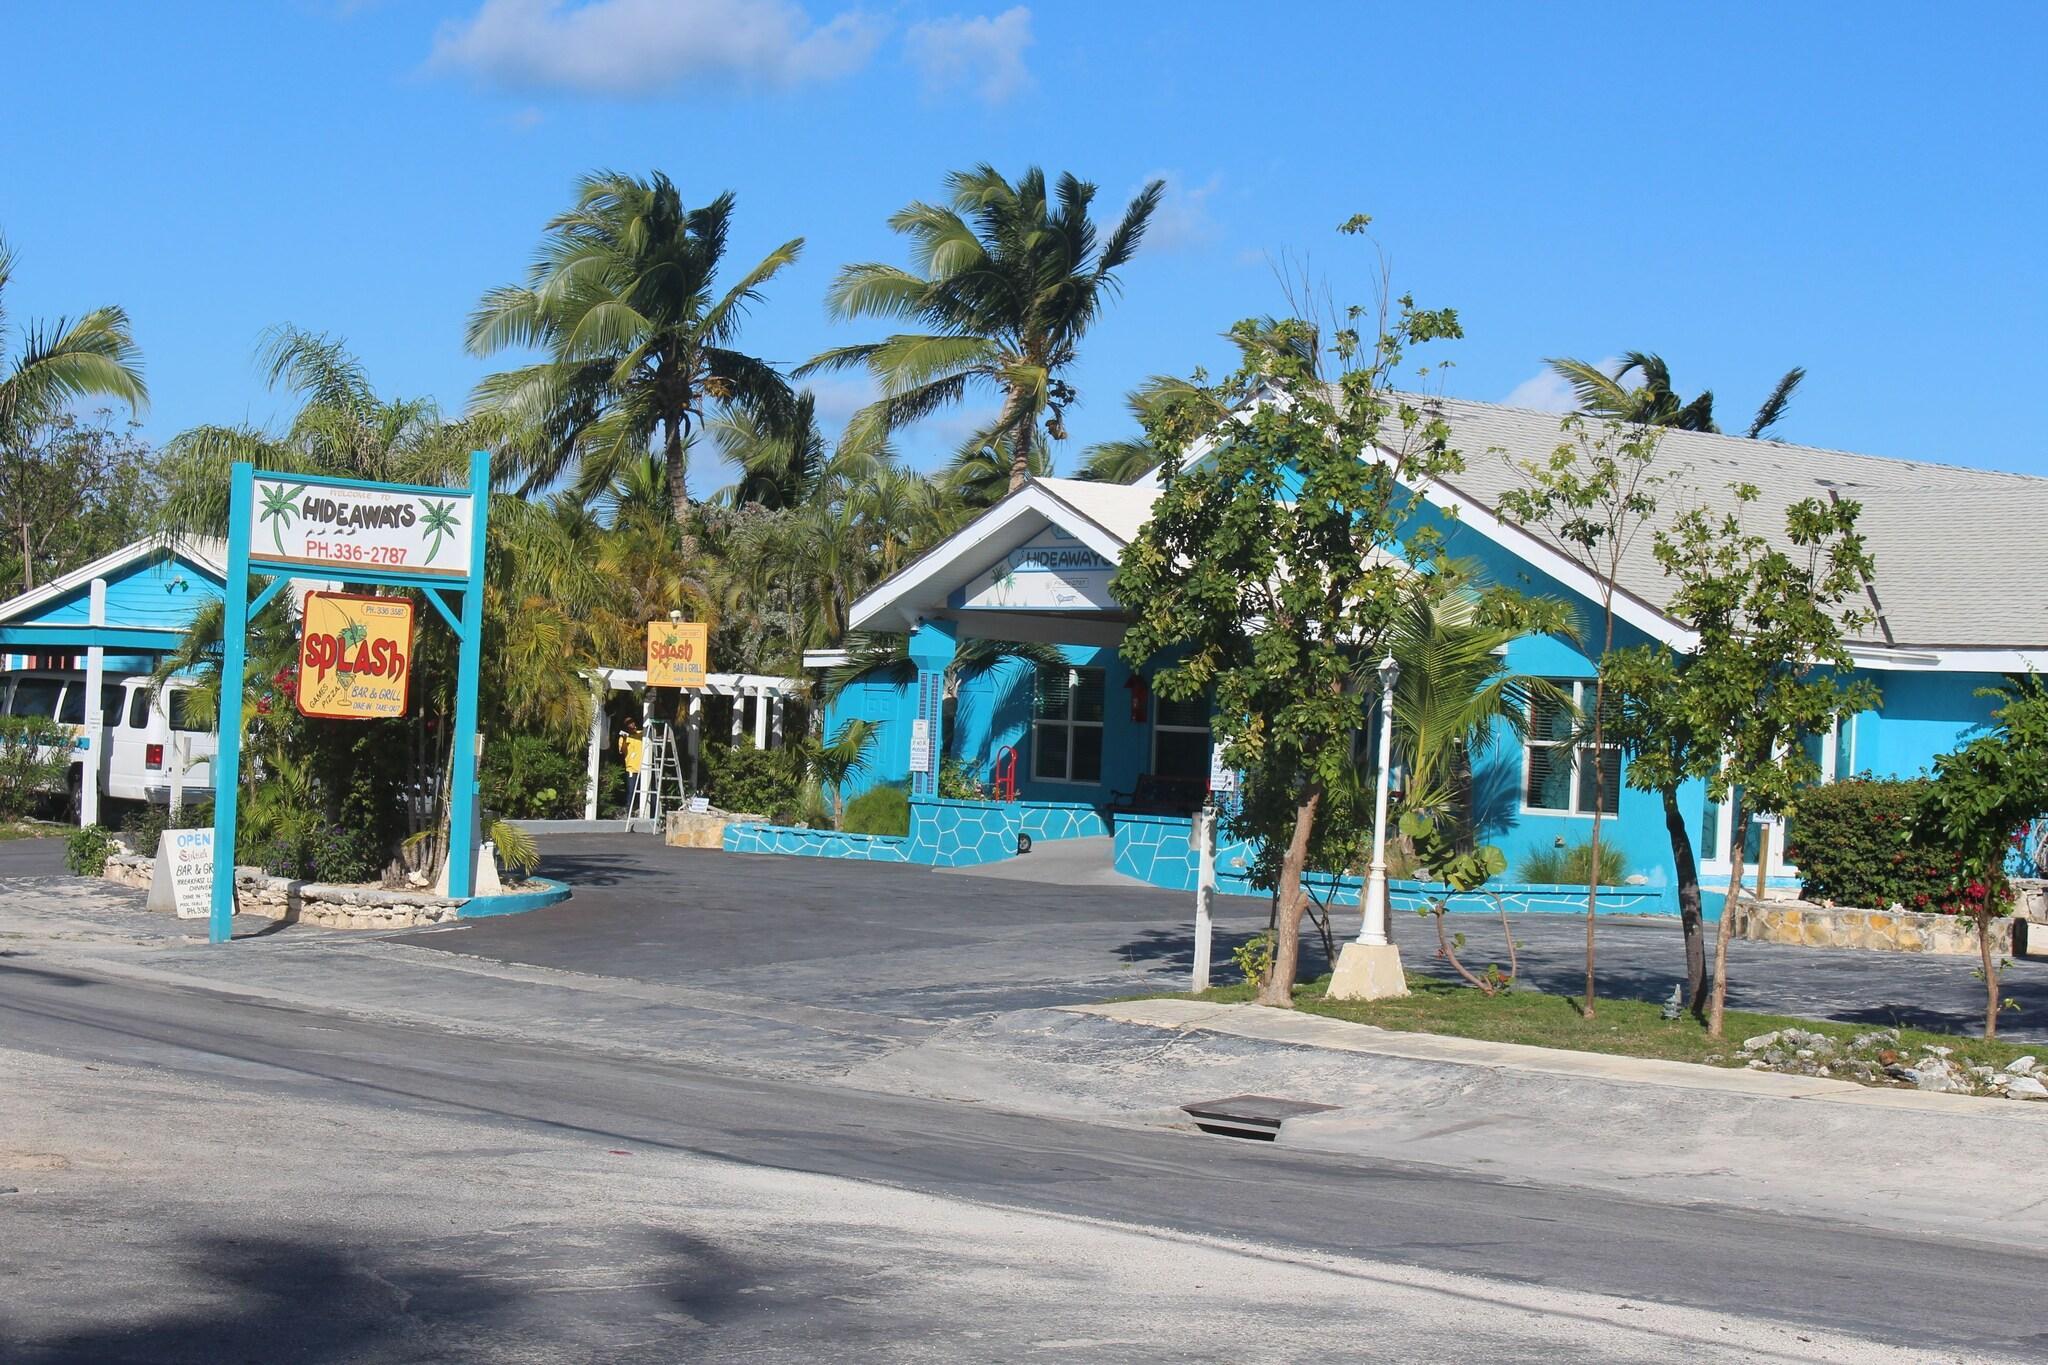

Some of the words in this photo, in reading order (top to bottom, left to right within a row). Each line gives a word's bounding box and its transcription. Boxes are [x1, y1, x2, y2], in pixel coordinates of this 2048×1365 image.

[302, 495, 416, 530] HIDEAWAYS
[306, 540, 407, 565] PH.336-2787
[309, 683, 329, 709] GAMES
[321, 686, 341, 709] PIZZA
[351, 685, 368, 699] BAR
[369, 687, 377, 699] &
[379, 688, 401, 702] GRILL
[178, 834, 210, 847] OPEN
[176, 864, 192, 877] BAR
[194, 863, 202, 875] &
